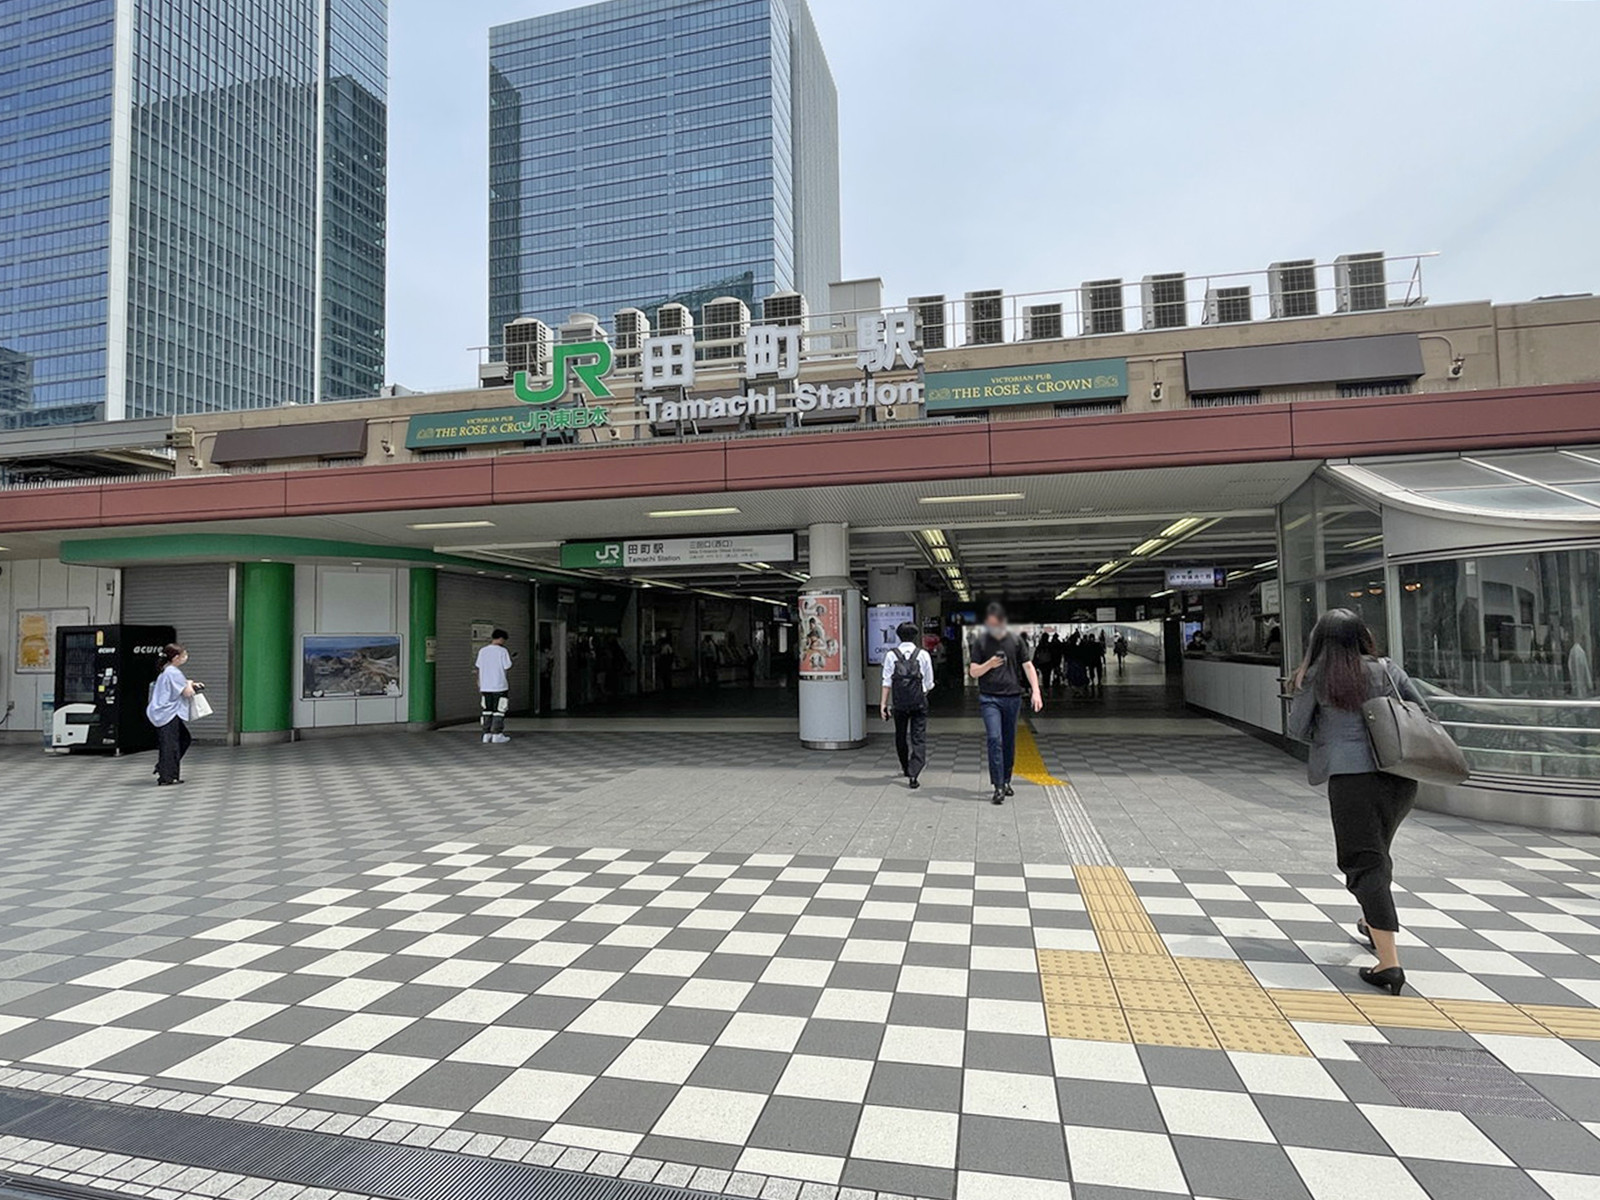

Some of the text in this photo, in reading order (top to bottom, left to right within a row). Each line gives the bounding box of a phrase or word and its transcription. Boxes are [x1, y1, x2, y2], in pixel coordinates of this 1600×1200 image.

[642, 312, 918, 391] 田町駅
[513, 341, 614, 403] JR
[991, 373, 1052, 384] VICTORIAN PUB
[952, 378, 1093, 399] THE ROSE & CROWN
[643, 379, 920, 422] Tamachi Station
[467, 416, 499, 424] VICTORIAN
[519, 407, 609, 432] JR東日本
[435, 426, 456, 437] THE
[459, 423, 487, 436] ROSE
[489, 424, 498, 433] &
[595, 545, 620, 559] JR
[628, 543, 664, 554] 田町駅
[133, 645, 164, 654] acure
